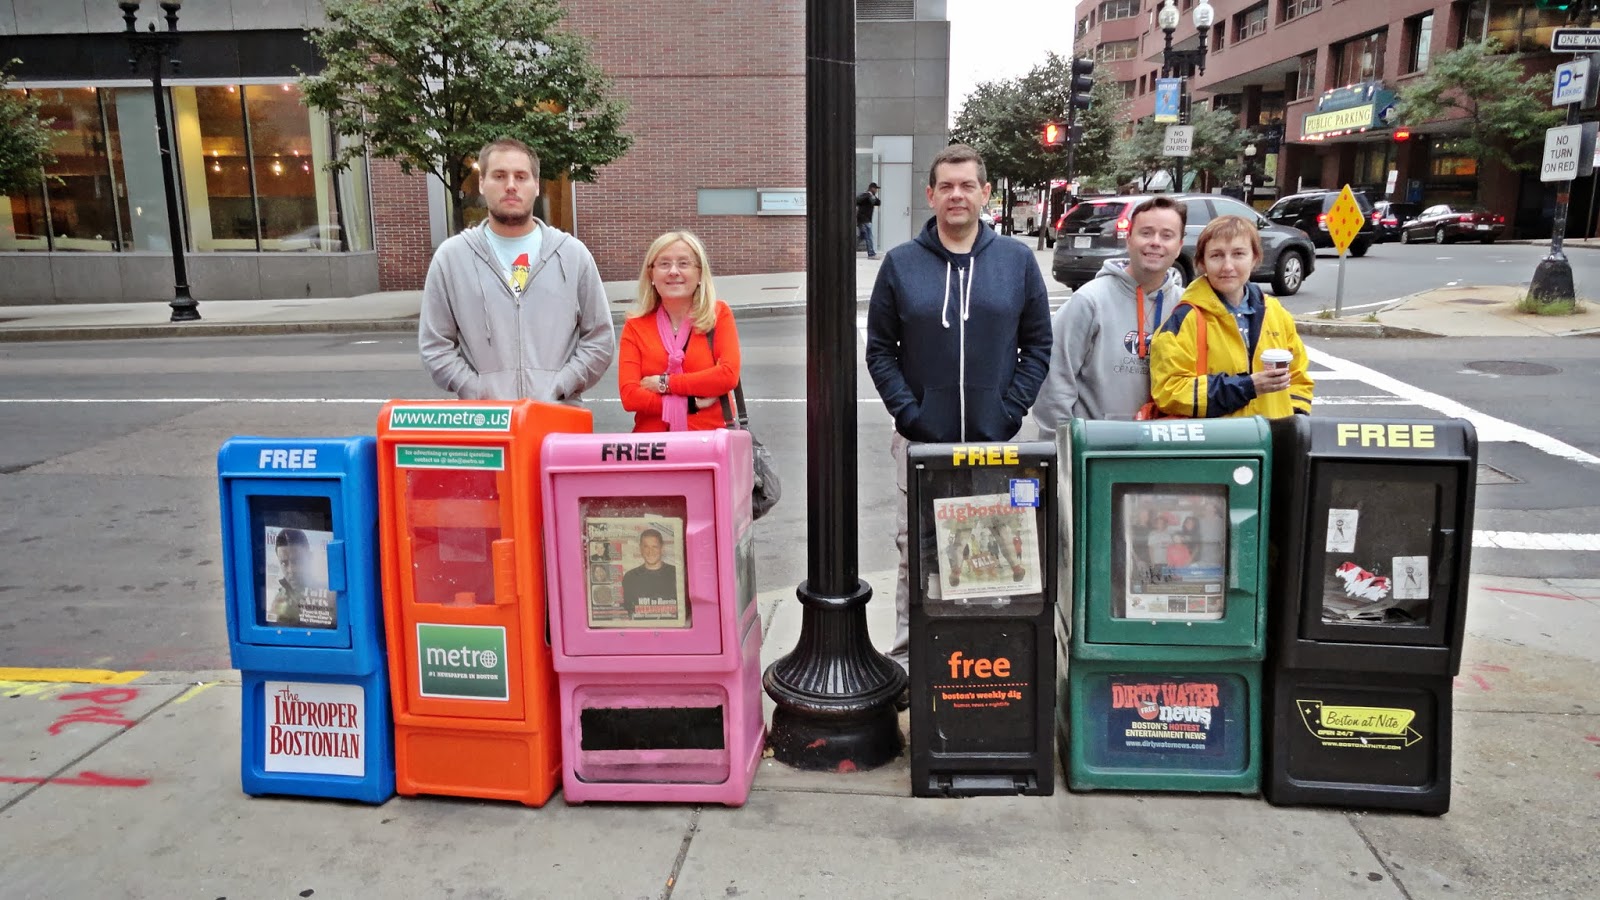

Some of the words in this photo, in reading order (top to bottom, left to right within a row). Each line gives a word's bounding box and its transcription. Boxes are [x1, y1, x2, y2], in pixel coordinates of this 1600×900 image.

[1561, 36, 1579, 44] ONE
[1307, 115, 1333, 130] PUBLIC
[1335, 108, 1370, 126] PARKING
[1556, 135, 1569, 145] NO
[1551, 148, 1573, 159] TURN
[1544, 163, 1556, 173] ON
[1558, 161, 1575, 171] RED
[393, 411, 508, 426] www.metro.us
[1337, 423, 1435, 448] FREE
[259, 449, 318, 469] FREE
[413, 449, 441, 457] advertising
[601, 442, 667, 461] FREE
[953, 446, 1019, 466] FREE
[972, 555, 995, 568] FALL
[427, 646, 498, 668] metro
[948, 651, 1010, 678] free
[279, 684, 299, 702] The
[942, 692, 975, 700] boston's
[976, 690, 1006, 700] weekly
[1112, 682, 1160, 709] DIRTY
[1161, 682, 1219, 709] WATER
[274, 695, 358, 729] IMPROPER
[1141, 706, 1156, 714] FREE
[1159, 705, 1211, 730] news
[1132, 721, 1168, 730] BOSTON'S
[1169, 723, 1200, 731] HOTTEST
[1326, 711, 1359, 727] Boston
[1361, 715, 1376, 727] at
[1375, 714, 1399, 728] Nite
[270, 725, 360, 759] BOSTONIAN
[1125, 729, 1184, 739] ENTERTAINMENT
[1185, 731, 1206, 740] NEWS
[1126, 740, 1205, 750] www.dirtywaternews.com
